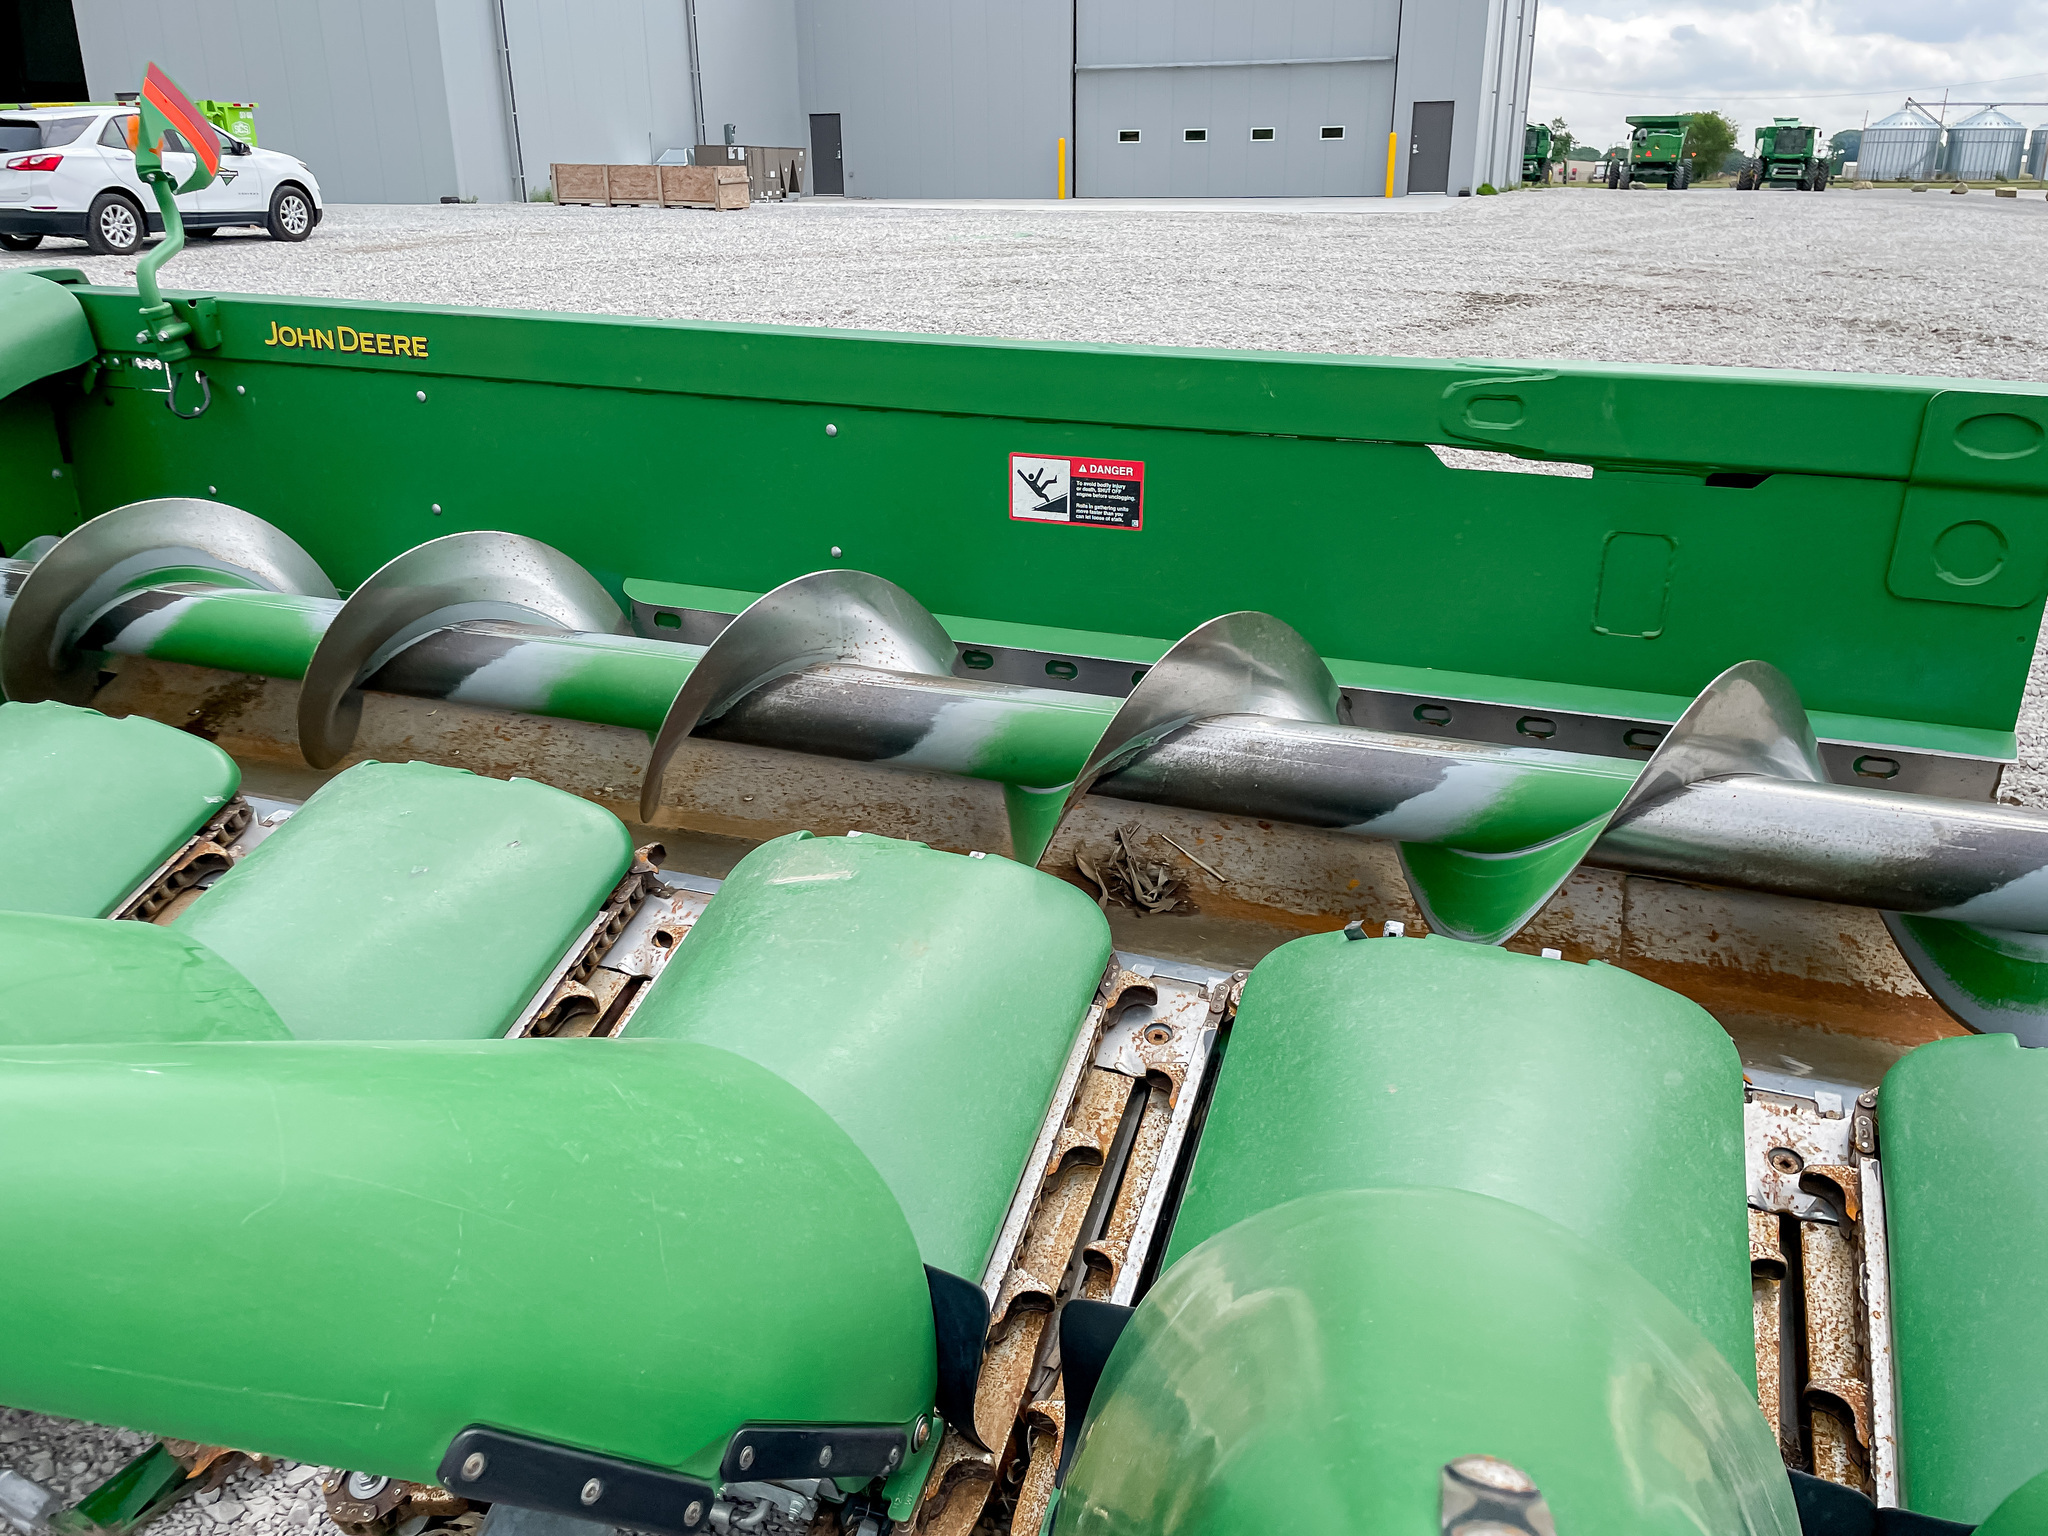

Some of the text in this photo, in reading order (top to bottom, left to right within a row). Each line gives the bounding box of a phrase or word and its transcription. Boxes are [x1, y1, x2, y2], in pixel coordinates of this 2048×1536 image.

[264, 321, 430, 359] JOHN DEERE
[1089, 464, 1133, 476] DANGER
[1094, 504, 1116, 512] gathering
